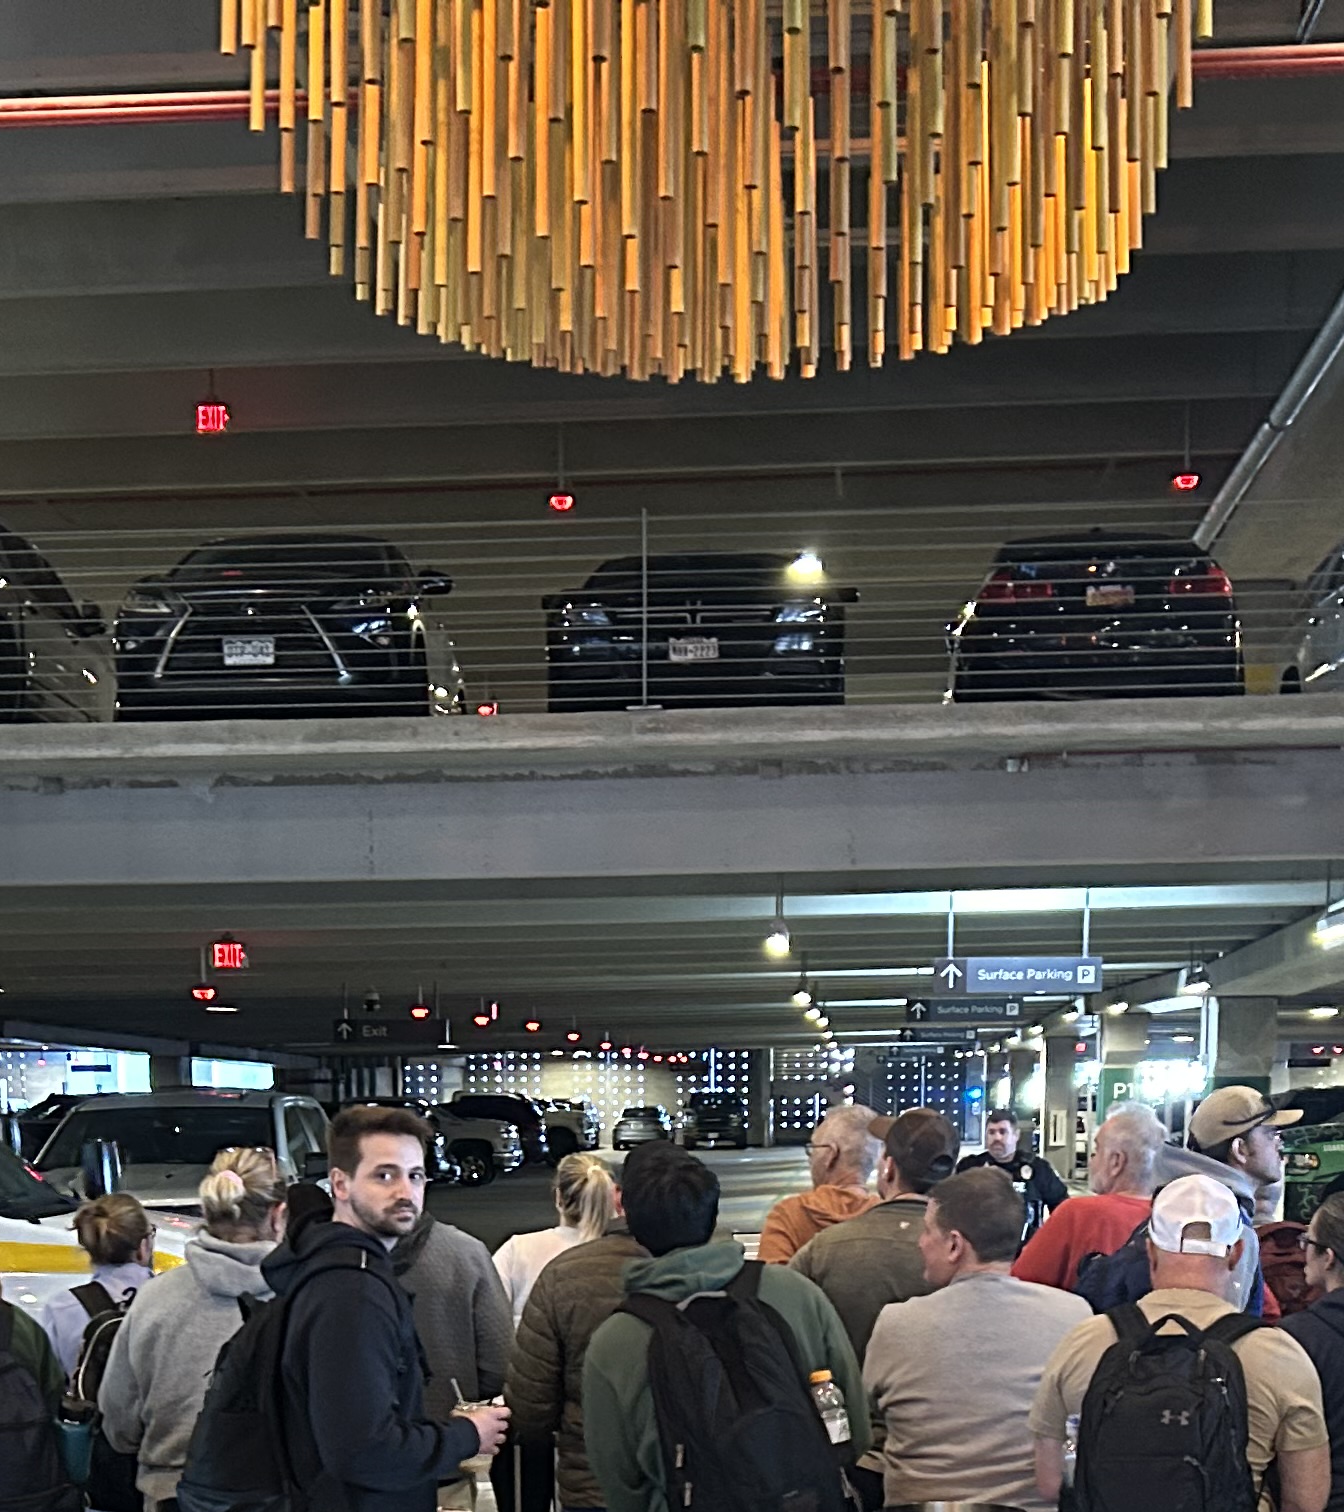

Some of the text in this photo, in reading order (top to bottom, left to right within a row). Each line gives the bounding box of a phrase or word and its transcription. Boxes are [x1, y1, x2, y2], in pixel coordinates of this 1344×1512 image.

[197, 405, 226, 430] EXIT
[214, 943, 243, 968] EXIT
[977, 968, 1024, 981] Surface
[1026, 968, 1073, 981] Parking
[937, 1005, 970, 1014] Surface
[971, 1004, 1003, 1015] Parking
[362, 1025, 388, 1037] Exit
